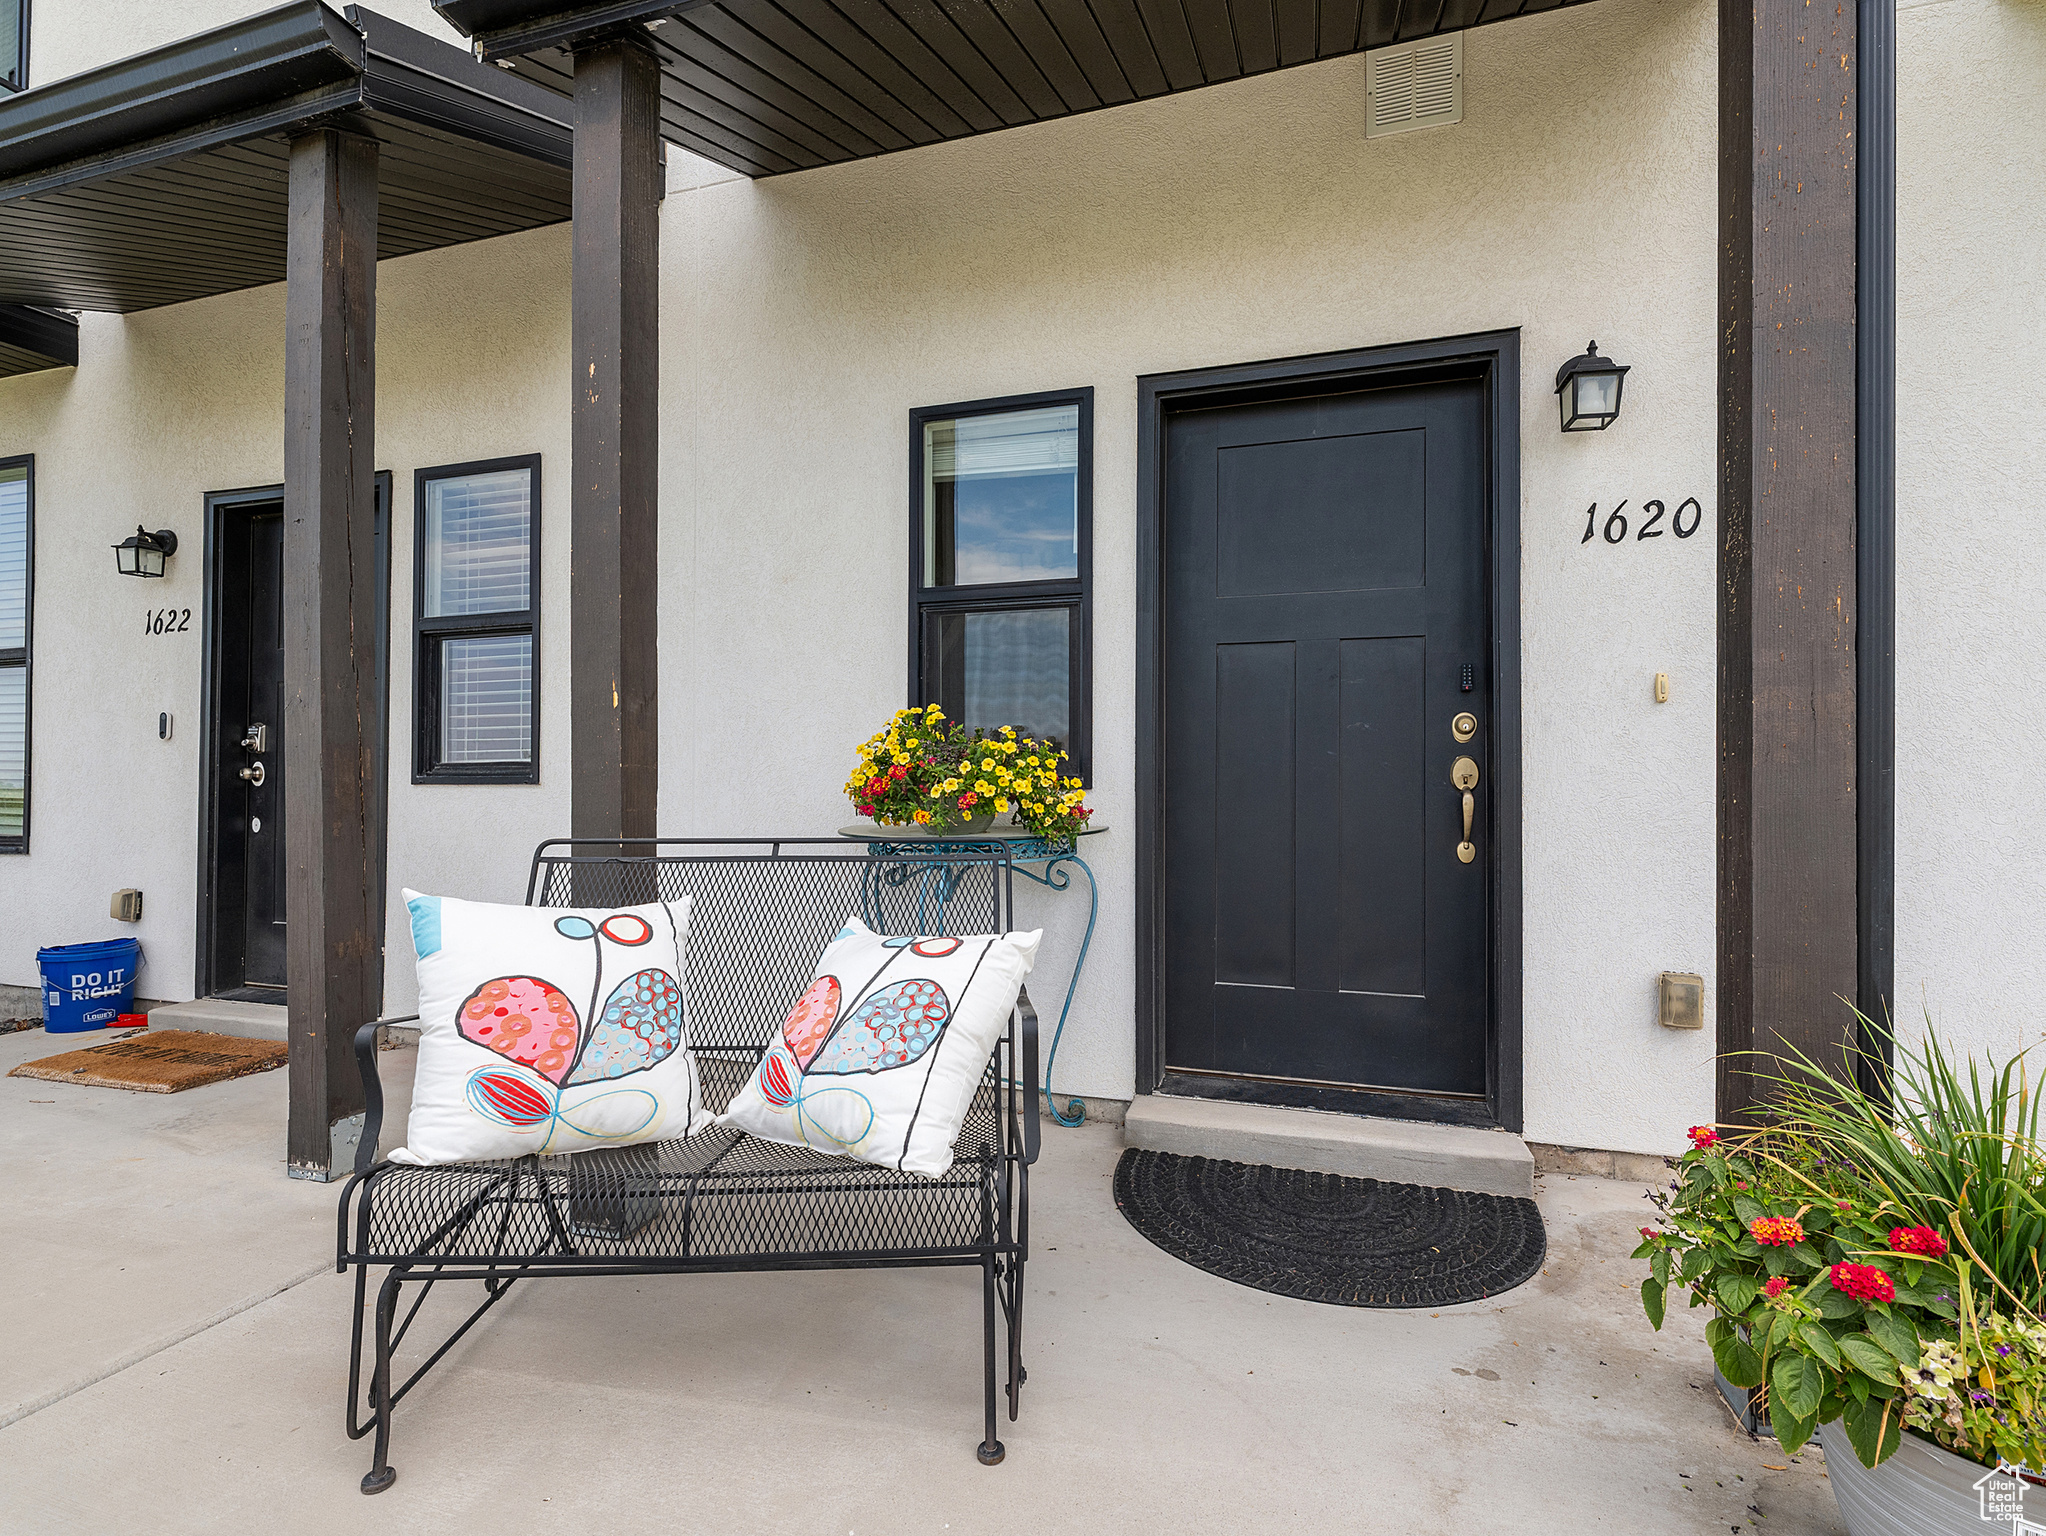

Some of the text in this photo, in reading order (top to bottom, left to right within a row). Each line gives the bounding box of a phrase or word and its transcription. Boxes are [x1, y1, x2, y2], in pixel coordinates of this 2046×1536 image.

[1580, 496, 1702, 544] 1620
[145, 608, 191, 635] 1622
[71, 968, 124, 988] DO IT
